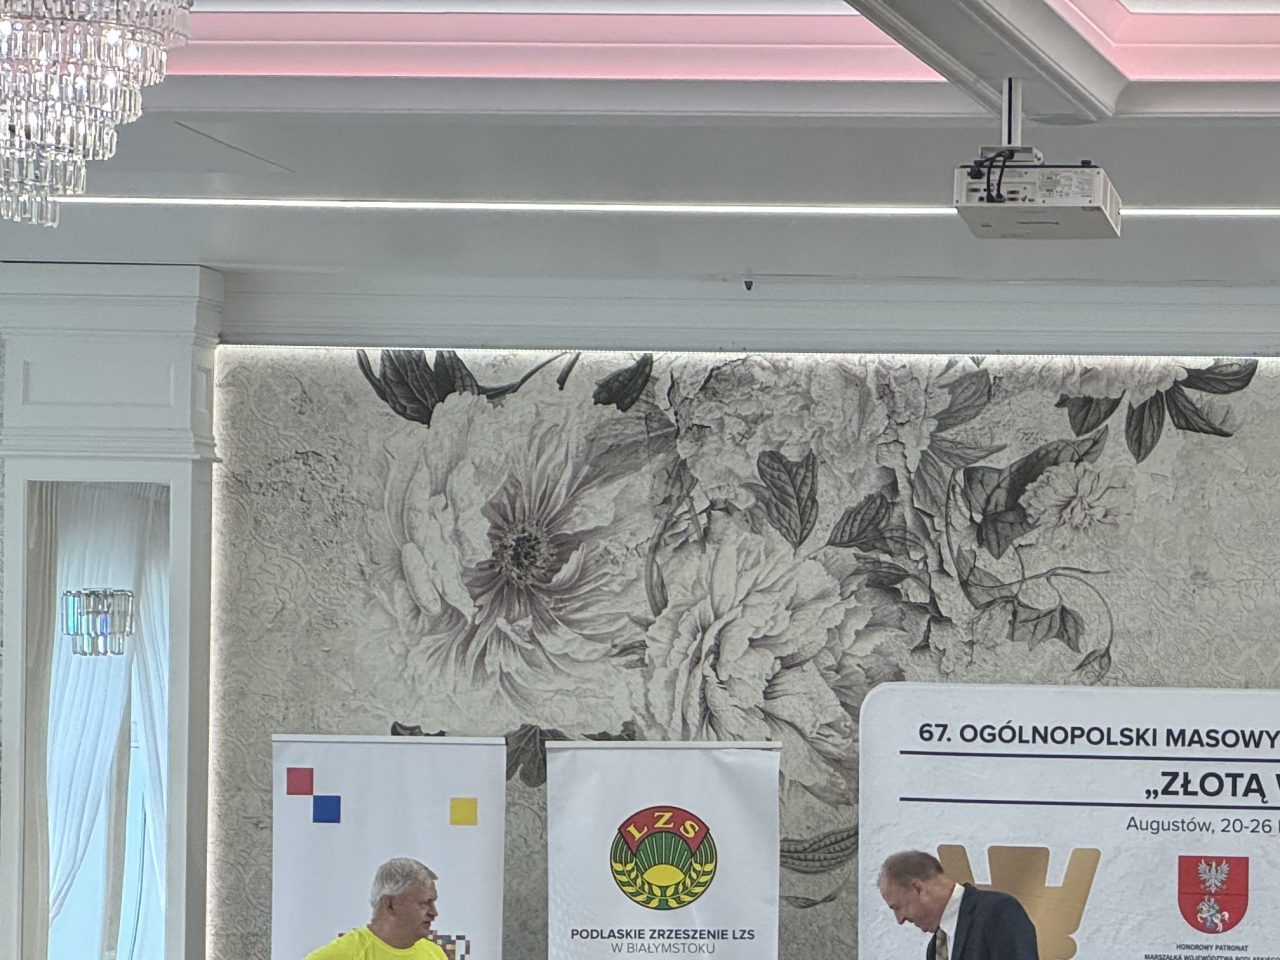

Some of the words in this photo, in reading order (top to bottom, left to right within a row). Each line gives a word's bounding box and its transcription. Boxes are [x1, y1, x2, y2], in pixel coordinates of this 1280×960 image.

[918, 723, 952, 742] 67.
[959, 720, 1157, 747] OGÓLNOPOLSKI
[1166, 728, 1280, 749] MASOWY
[626, 811, 699, 841] LZS
[1126, 816, 1215, 835] Augustów,
[1220, 818, 1272, 833] 20-26
[571, 928, 645, 940] PODLASKIE
[649, 928, 729, 940] ZRZESZENIE
[732, 929, 755, 940] LZS
[611, 943, 624, 953] W
[627, 942, 715, 954] BIAŁYMSTOKU
[1215, 944, 1248, 952] PATRONAT
